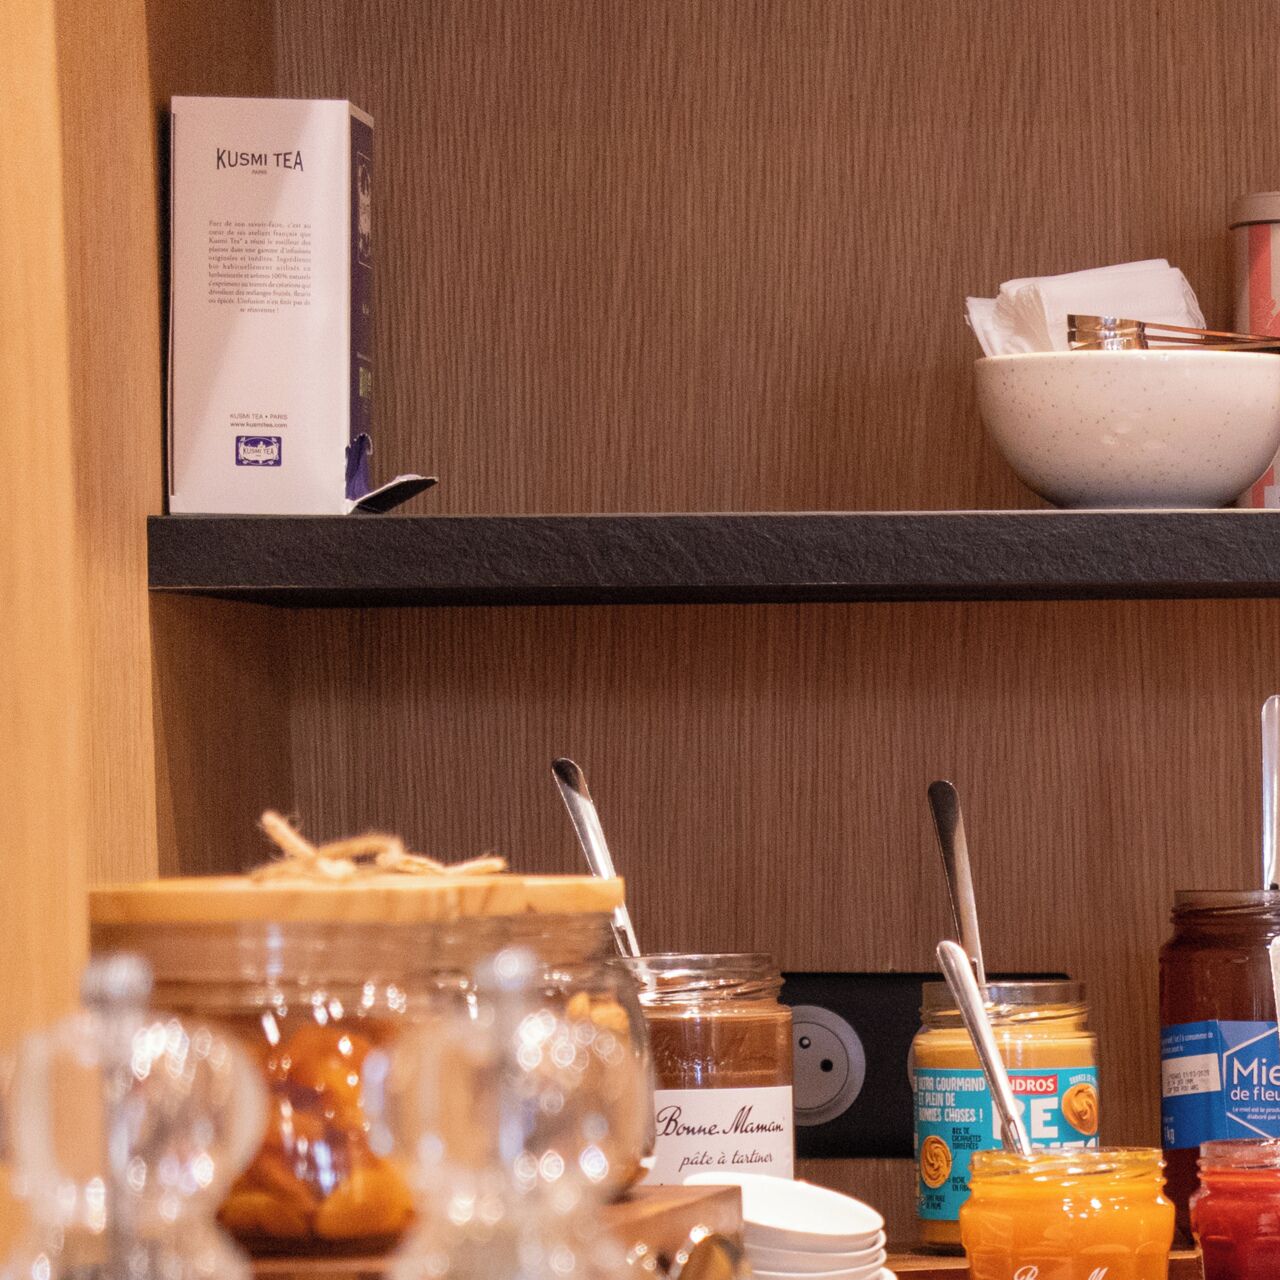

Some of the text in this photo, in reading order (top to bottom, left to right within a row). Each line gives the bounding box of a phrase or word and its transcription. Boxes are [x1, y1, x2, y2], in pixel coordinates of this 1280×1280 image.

[217, 148, 304, 171] KUSMI TEA
[936, 1076, 985, 1091] GOURMAND
[1009, 1077, 1055, 1091] NDROS
[945, 1092, 956, 1106] DE
[1230, 1086, 1249, 1101] de
[656, 1105, 783, 1137] Bonne Maman
[944, 1107, 976, 1122] CHOSES
[678, 1149, 773, 1173] pâte à tartiner
